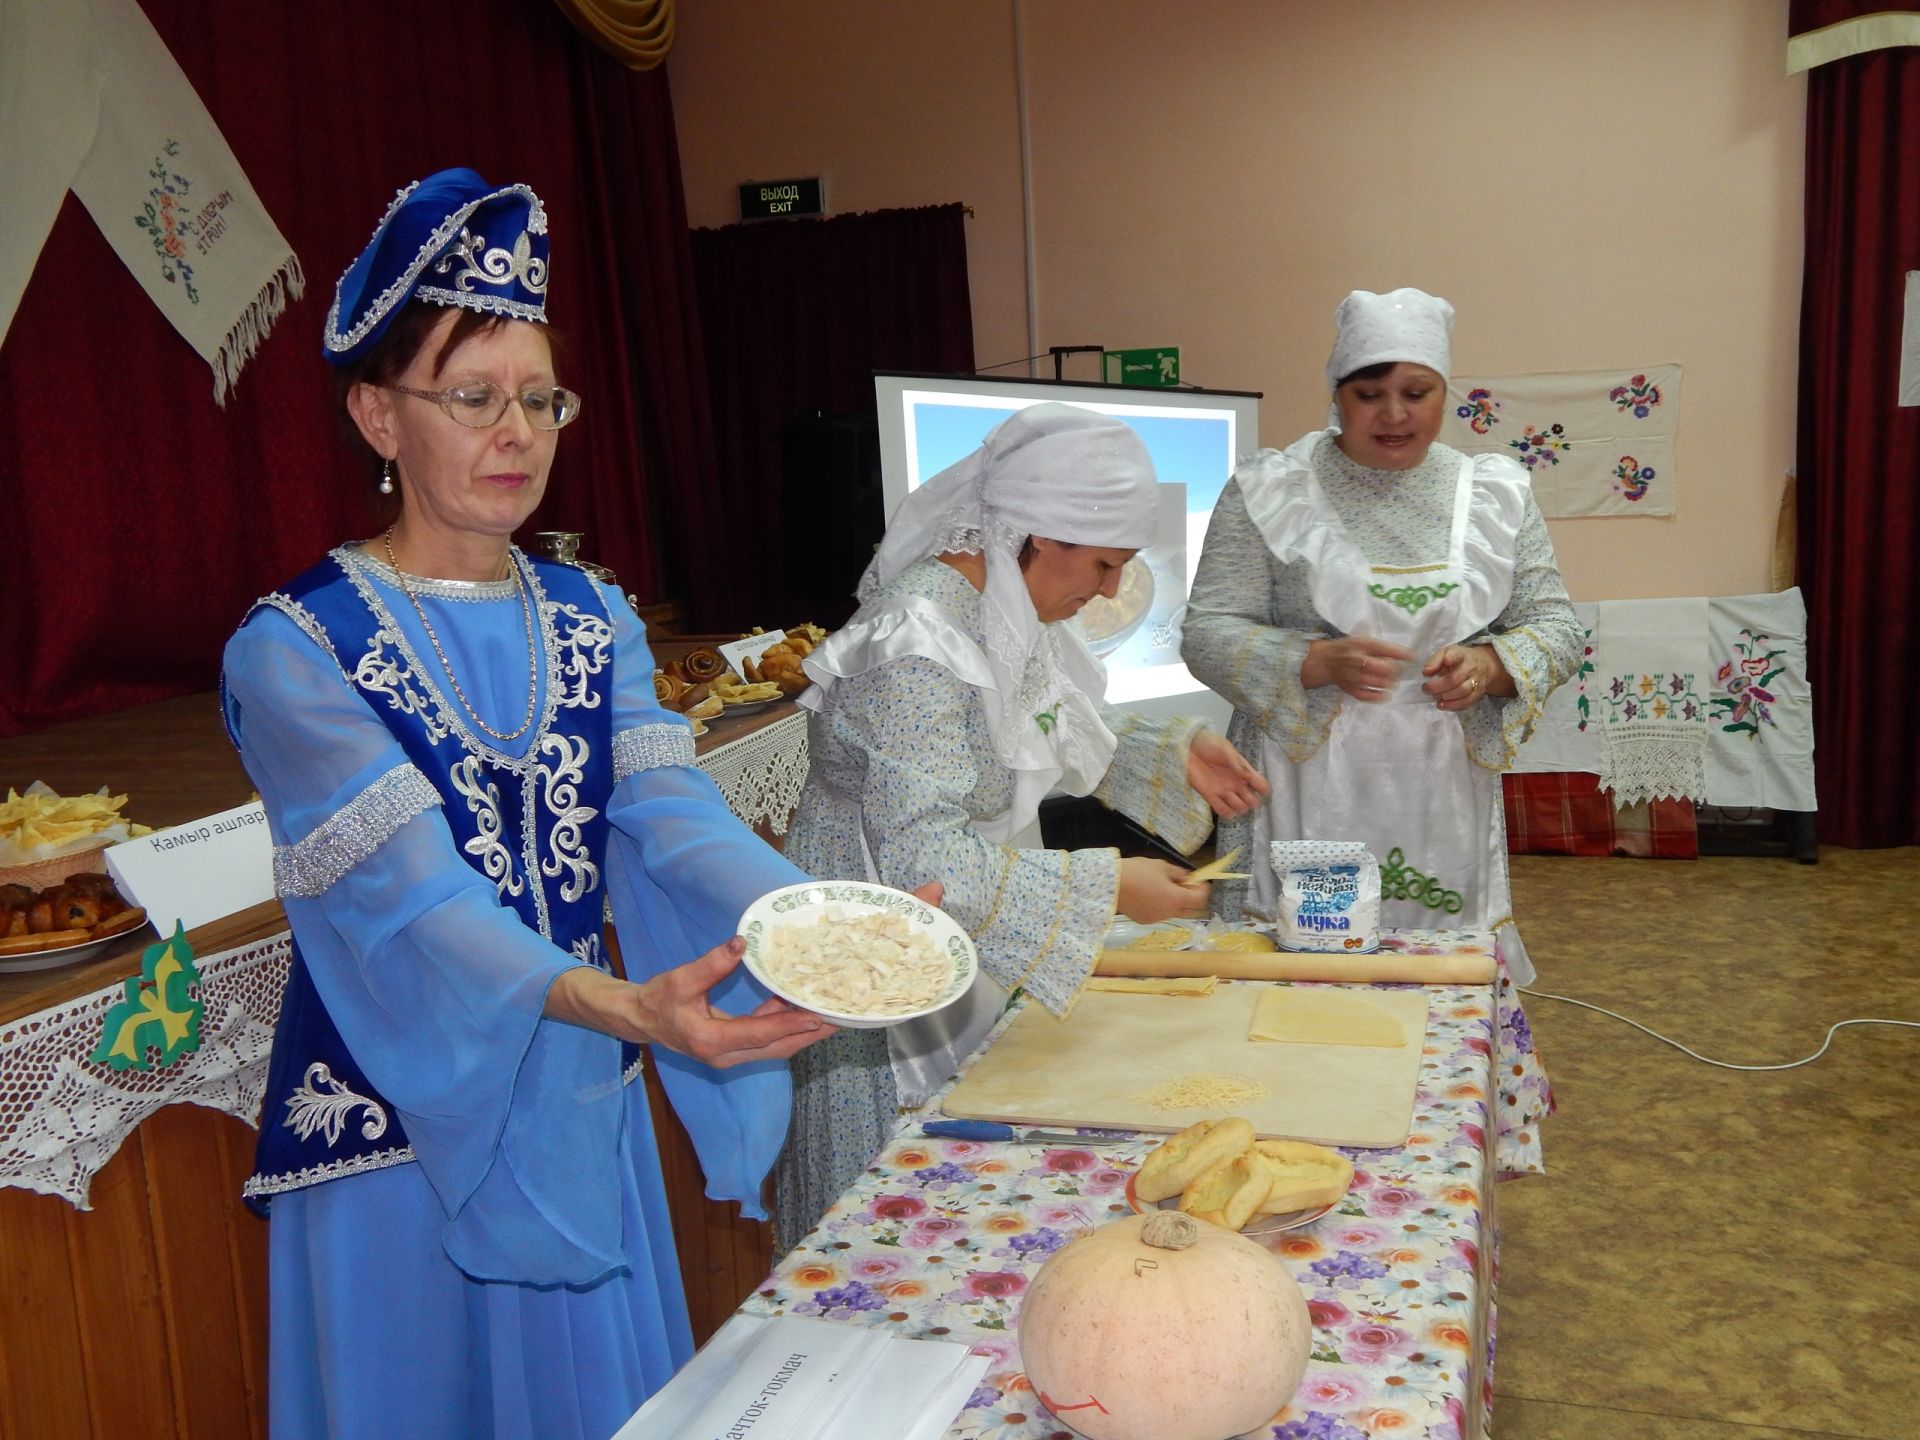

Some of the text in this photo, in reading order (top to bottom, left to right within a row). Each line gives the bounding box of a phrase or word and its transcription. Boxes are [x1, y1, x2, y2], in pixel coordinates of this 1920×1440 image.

[760, 185, 799, 201] ВЫХОД
[196, 190, 235, 230] ДОБРЫМ
[770, 201, 793, 213] EXIT
[150, 826, 211, 852] Камыр
[715, 1353, 808, 1440] ачток-токмач
